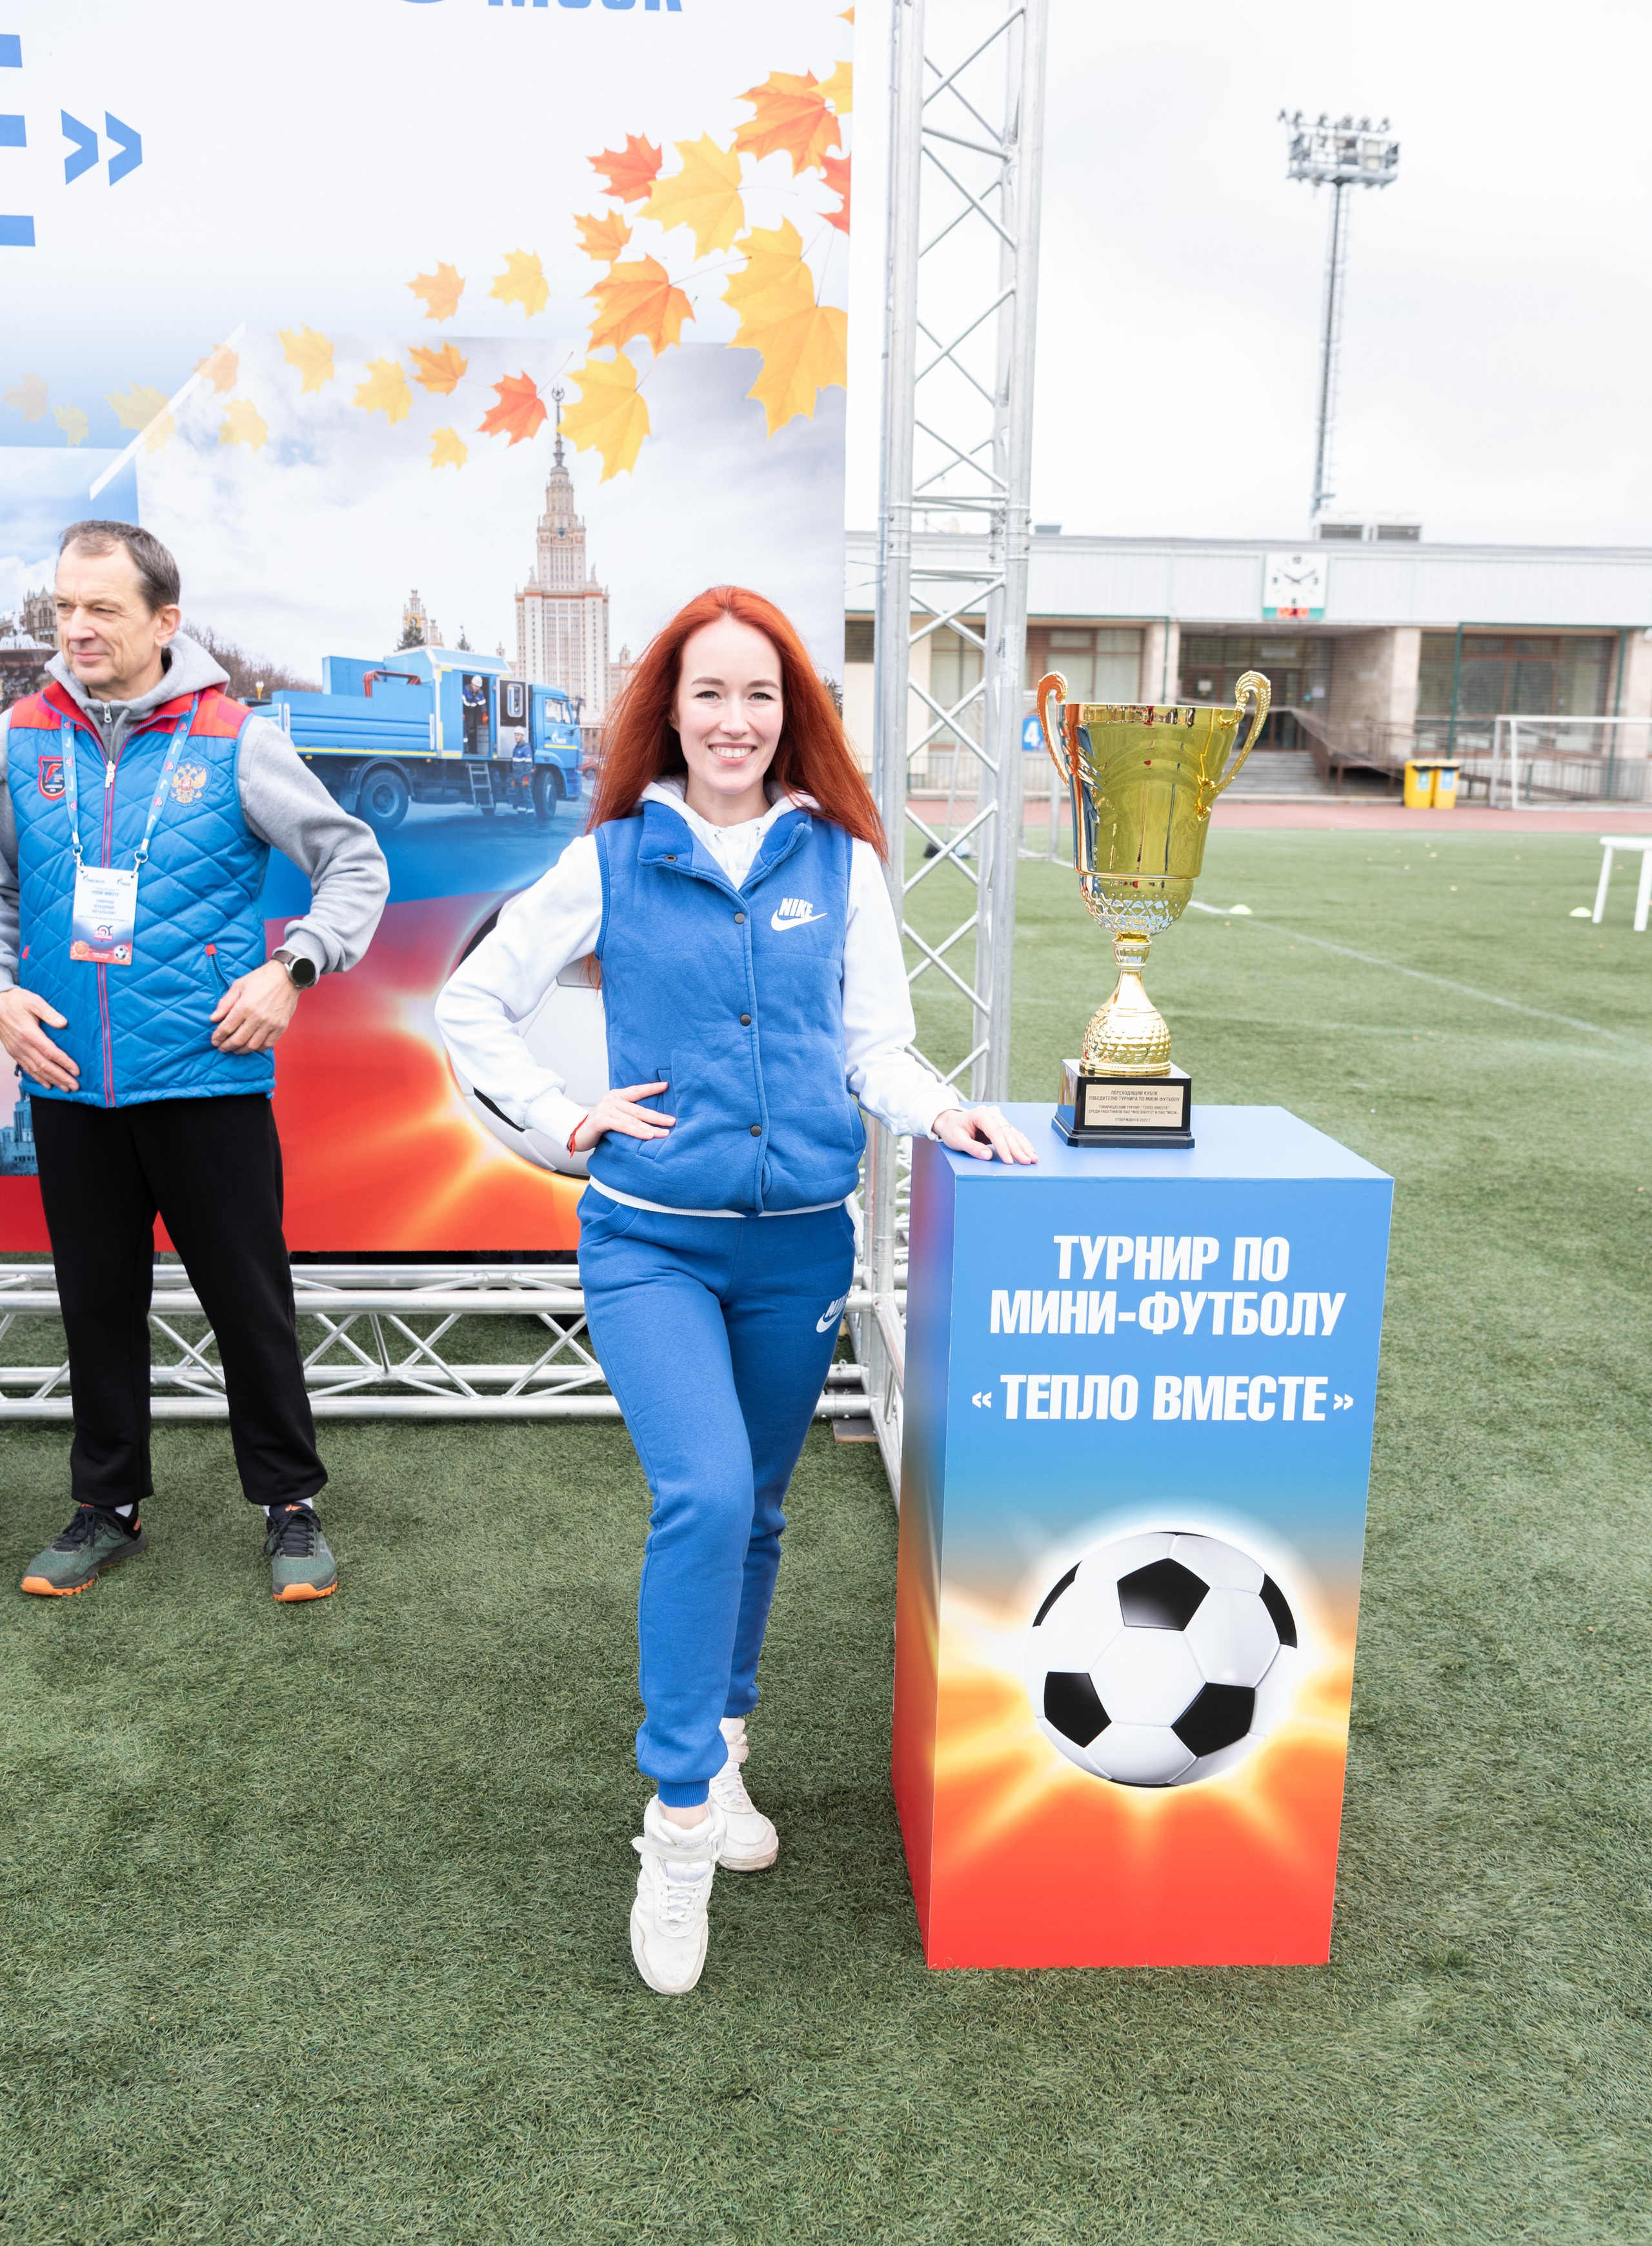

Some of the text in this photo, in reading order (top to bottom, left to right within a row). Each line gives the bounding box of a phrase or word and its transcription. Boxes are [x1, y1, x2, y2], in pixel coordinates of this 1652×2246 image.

[1024, 721, 1040, 747] 4
[778, 898, 813, 918] NIKE
[1054, 1235, 1290, 1282] ТУРНИР ПО
[990, 1290, 1347, 1336] МИНИ-ФУТБОЛУ
